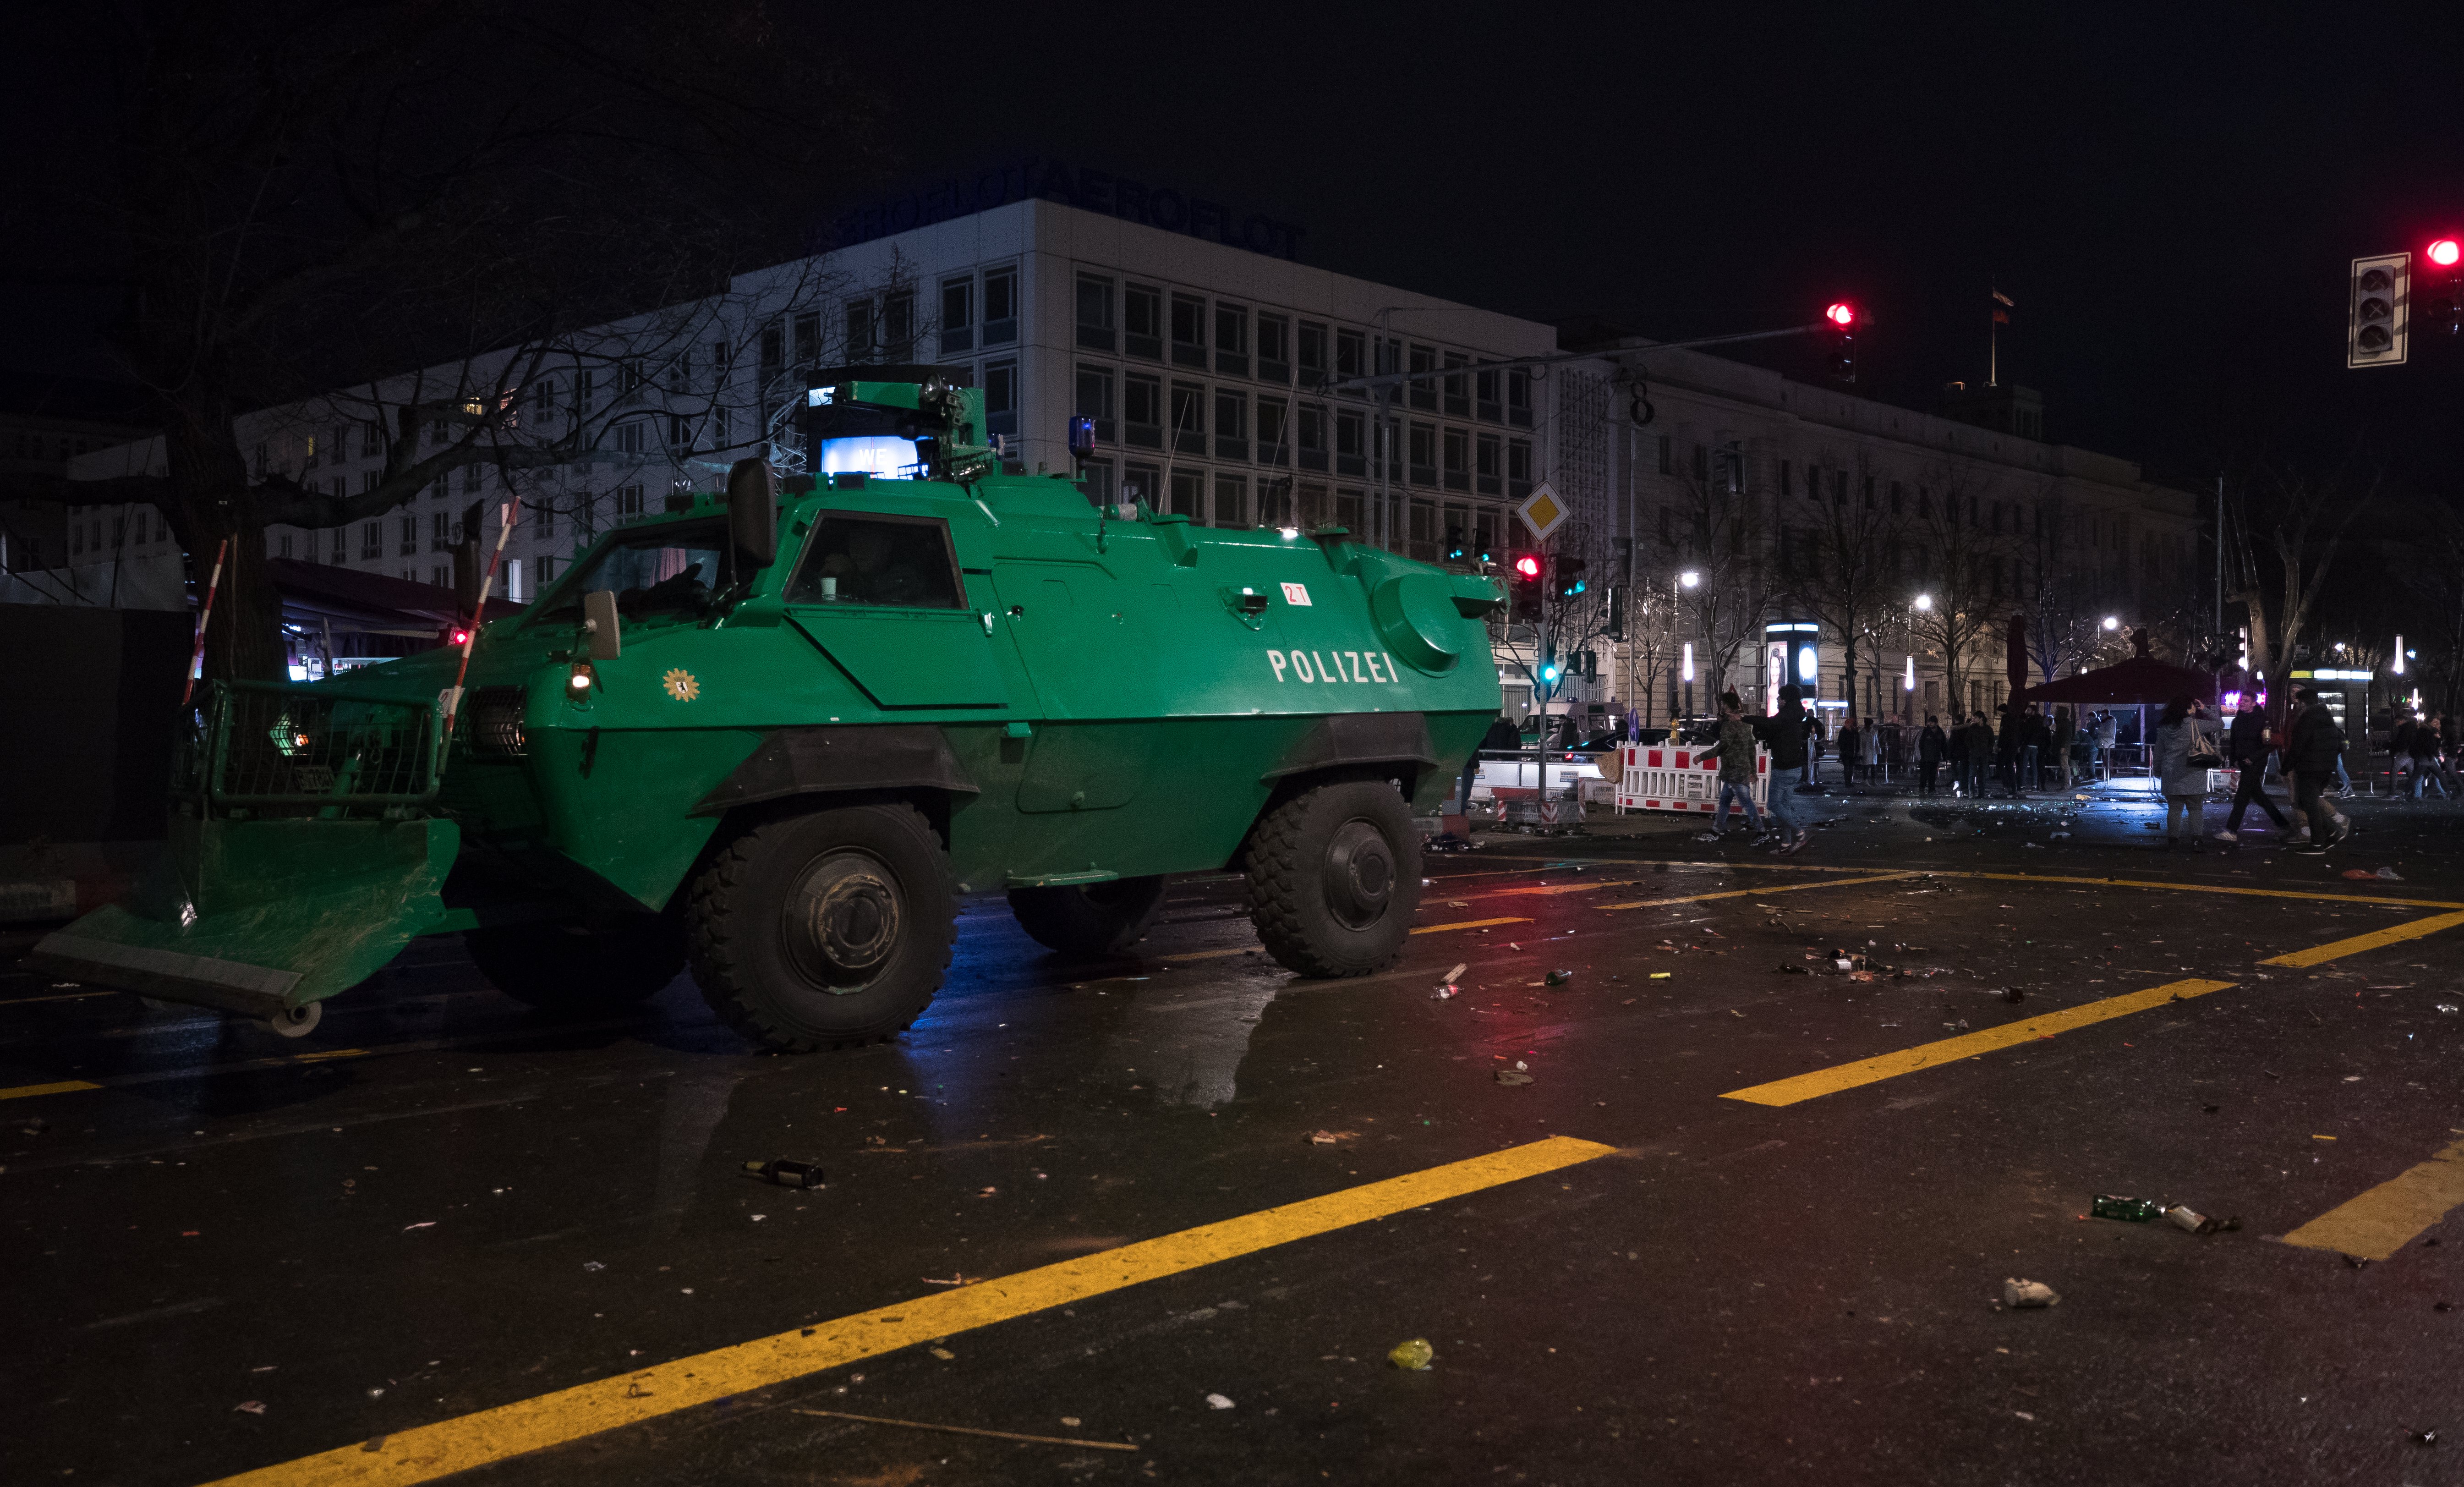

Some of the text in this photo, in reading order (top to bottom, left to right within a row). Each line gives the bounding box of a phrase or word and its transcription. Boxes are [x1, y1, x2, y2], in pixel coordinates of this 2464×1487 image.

[810, 155, 1039, 254] EROFLOT
[1036, 159, 1307, 260] AEROFLOT
[859, 448, 887, 466] WE
[1266, 650, 1399, 683] POLIZEI
